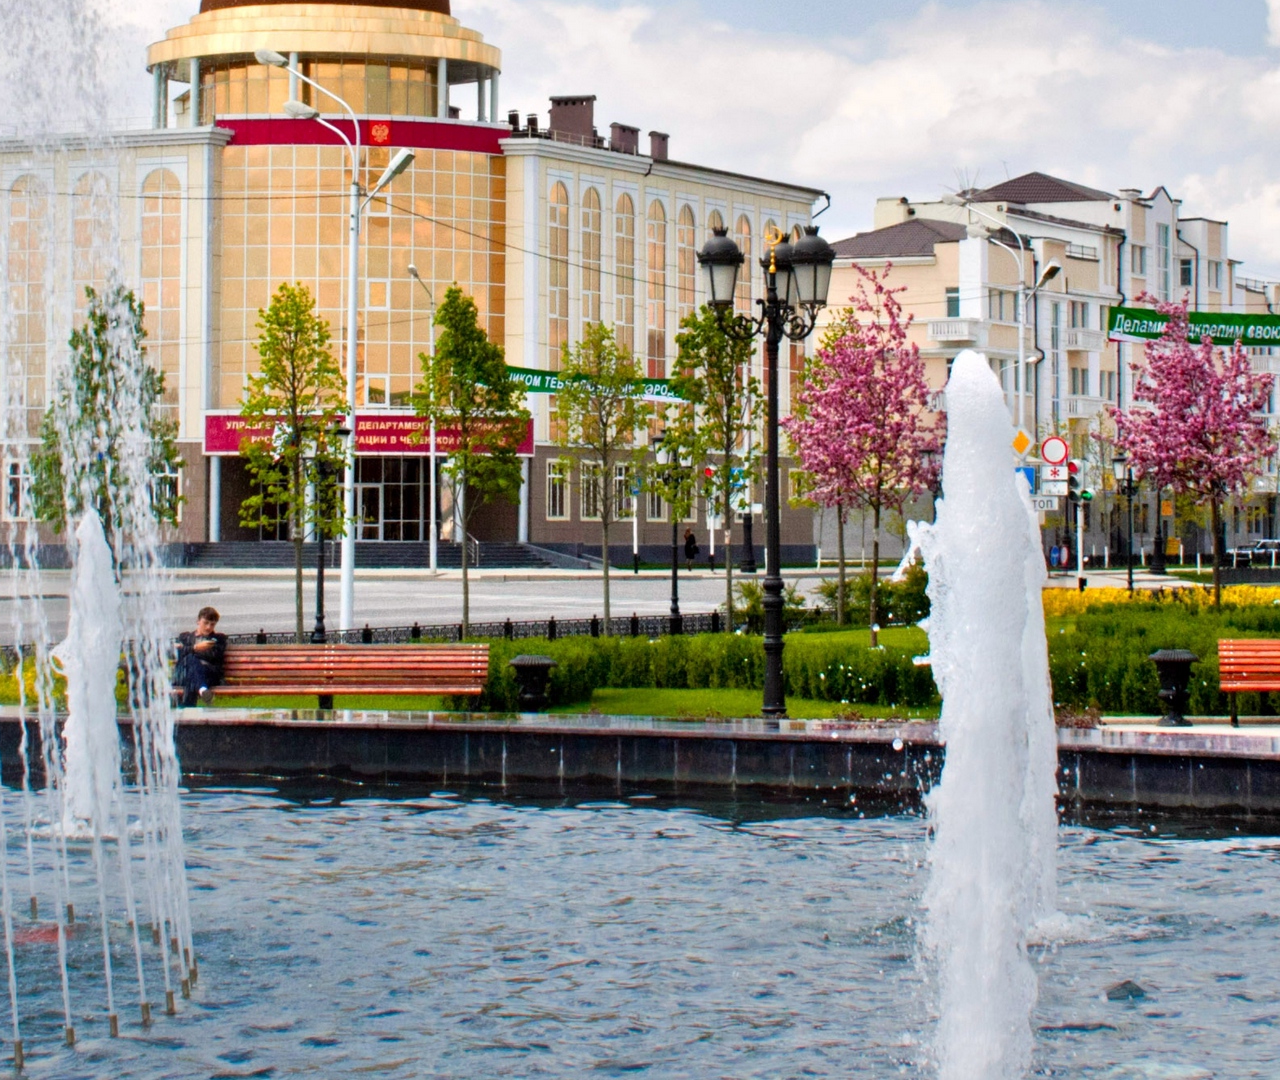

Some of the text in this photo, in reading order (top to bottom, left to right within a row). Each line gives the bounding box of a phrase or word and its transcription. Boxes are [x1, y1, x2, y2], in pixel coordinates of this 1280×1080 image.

[1177, 322, 1245, 338] дкрепим
[357, 421, 430, 431] ДЕПАРТАМЕНТ
[390, 435, 397, 445] В
[1031, 499, 1053, 509] ТОП
